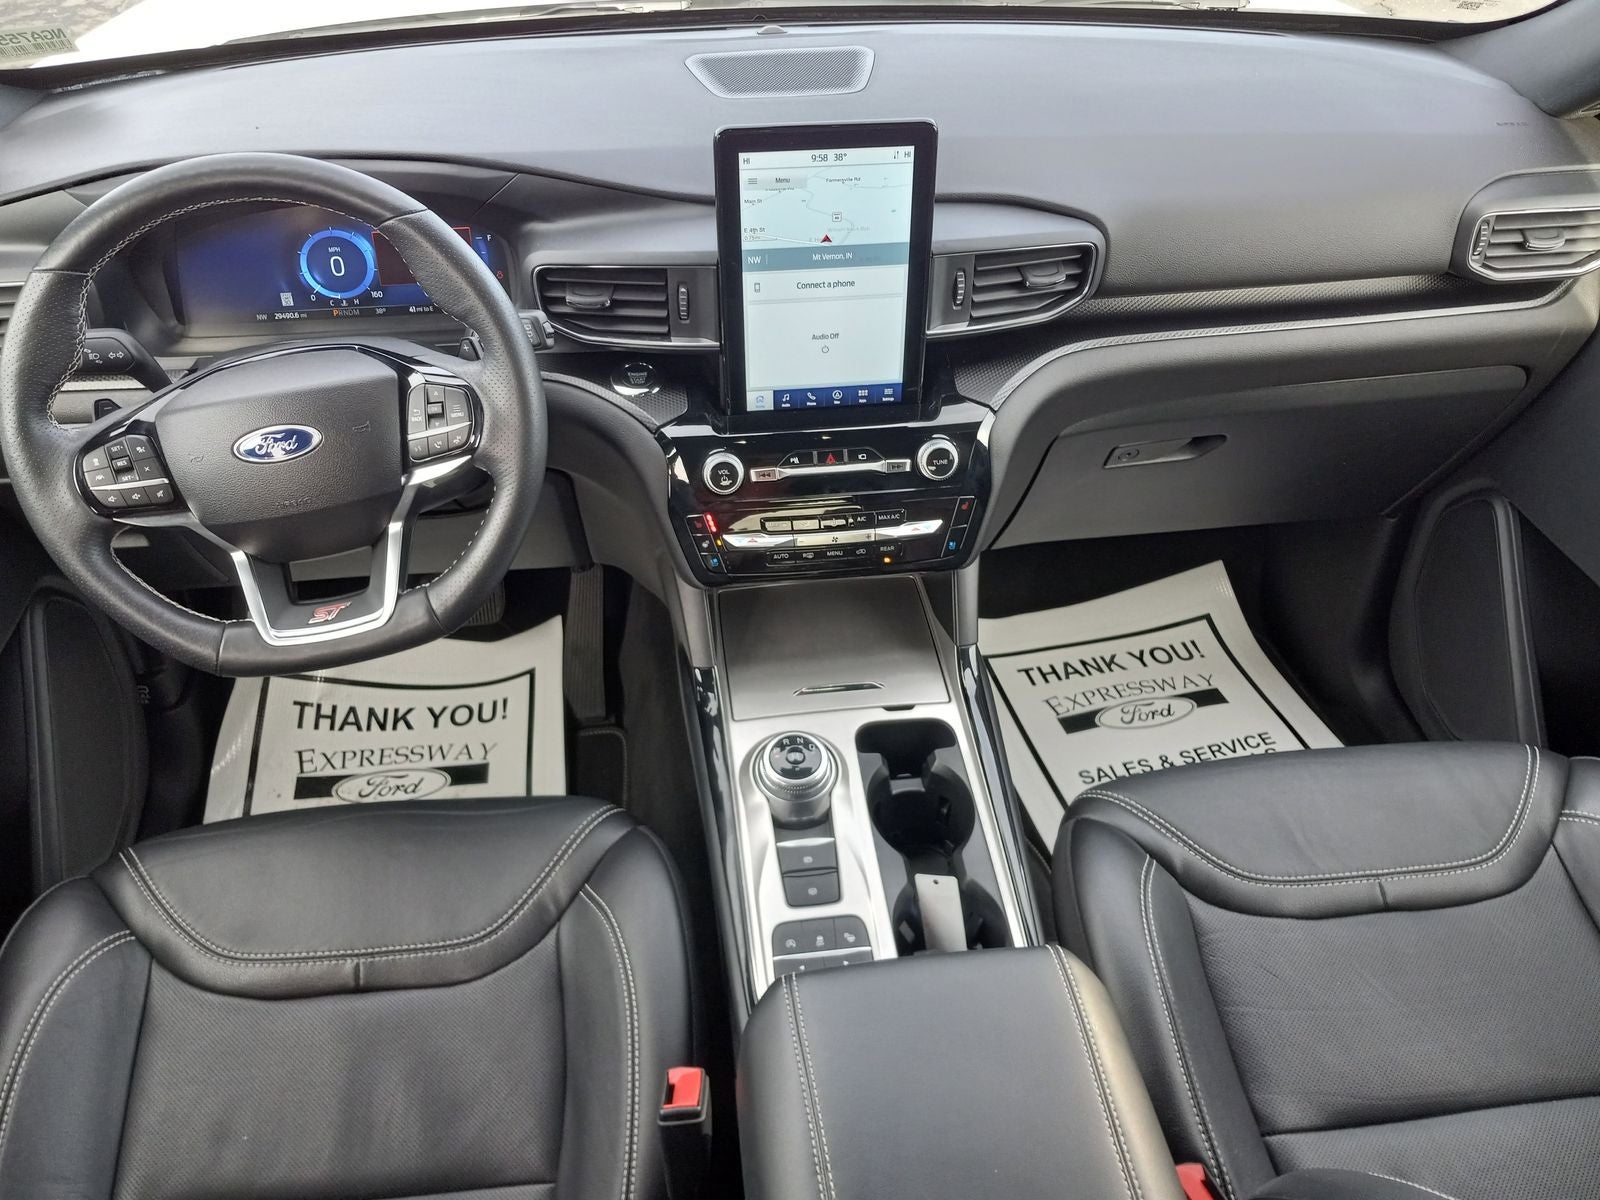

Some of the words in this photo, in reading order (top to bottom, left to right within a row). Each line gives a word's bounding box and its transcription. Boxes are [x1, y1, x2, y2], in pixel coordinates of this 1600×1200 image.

[811, 154, 828, 162] 9:58
[834, 152, 848, 162] 38°
[330, 256, 345, 276] 0
[748, 256, 762, 264] NW
[822, 252, 845, 261] Vernon,
[370, 290, 383, 298] 160
[796, 280, 826, 290] Connect
[832, 280, 856, 290] phone
[254, 432, 299, 454] Ford
[308, 602, 352, 624] ST
[1017, 654, 1128, 687] THANK
[1127, 639, 1206, 668] YOU!
[1043, 674, 1217, 718] EXPRESSWAY
[292, 700, 414, 732] THANK
[428, 698, 509, 728] YOU!
[1120, 702, 1176, 725] Ford
[294, 742, 498, 774] EXPRESSWAY
[1160, 754, 1176, 768] &
[1179, 732, 1276, 763] SERVICE
[358, 774, 424, 799] Ford
